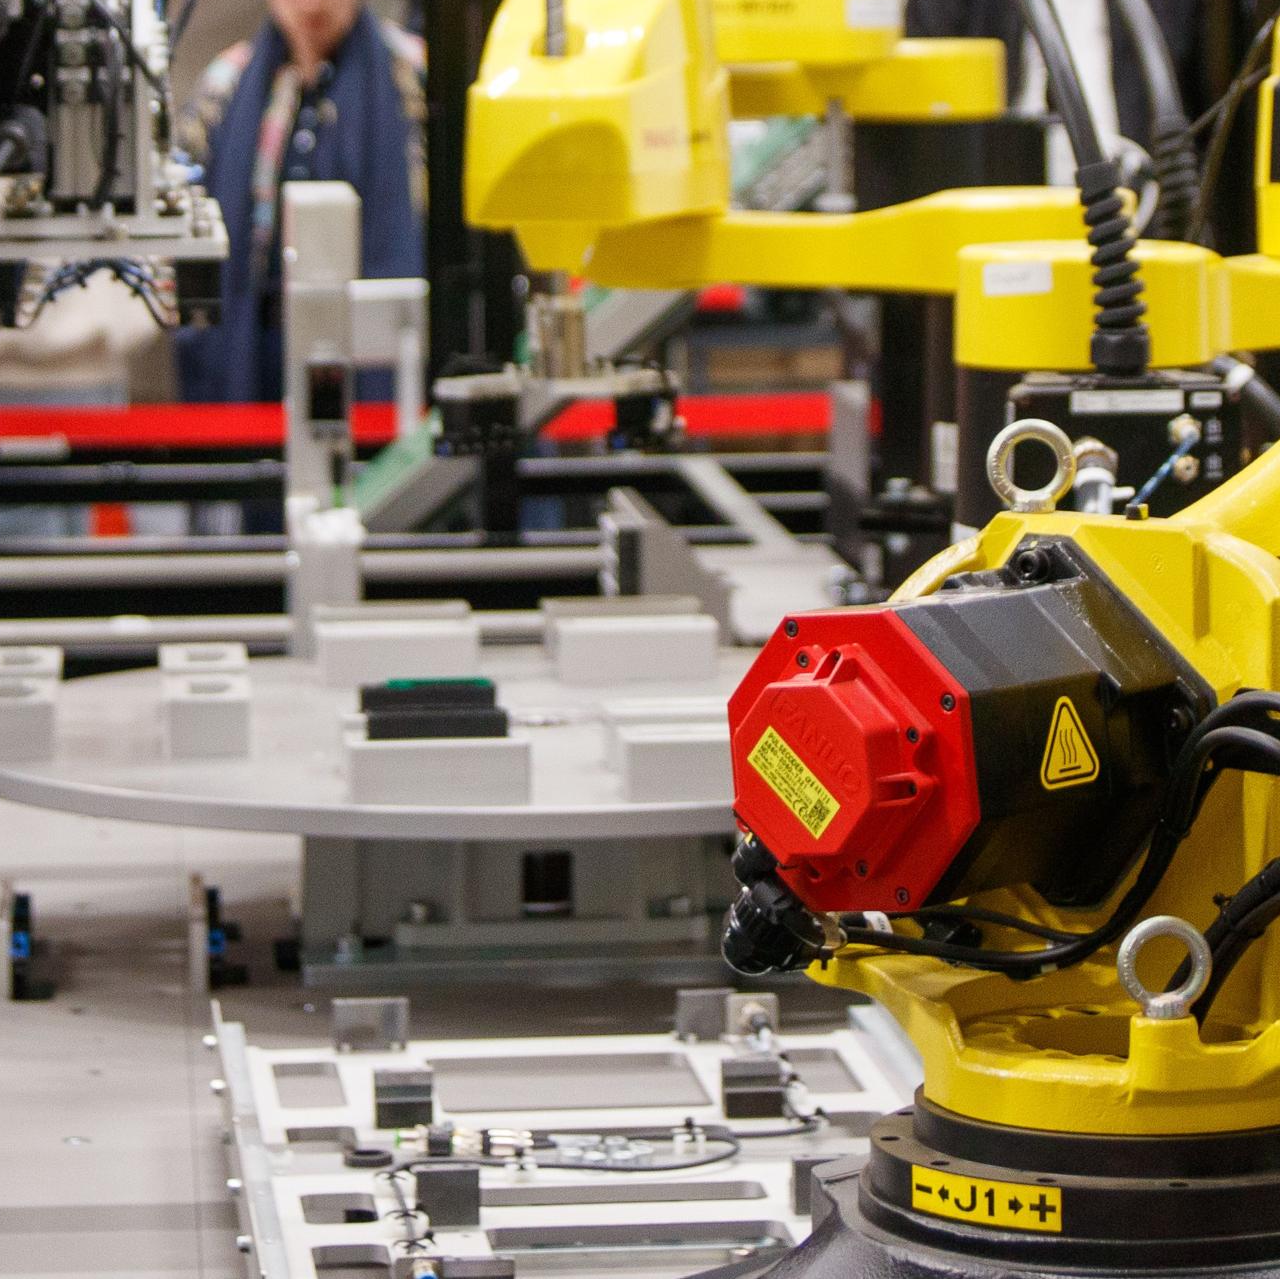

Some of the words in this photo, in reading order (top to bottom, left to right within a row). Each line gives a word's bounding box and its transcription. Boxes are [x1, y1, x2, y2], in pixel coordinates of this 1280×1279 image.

[768, 732, 805, 774] PULSECODER
[771, 689, 861, 792] FANUC
[954, 1185, 994, 1217] J1
